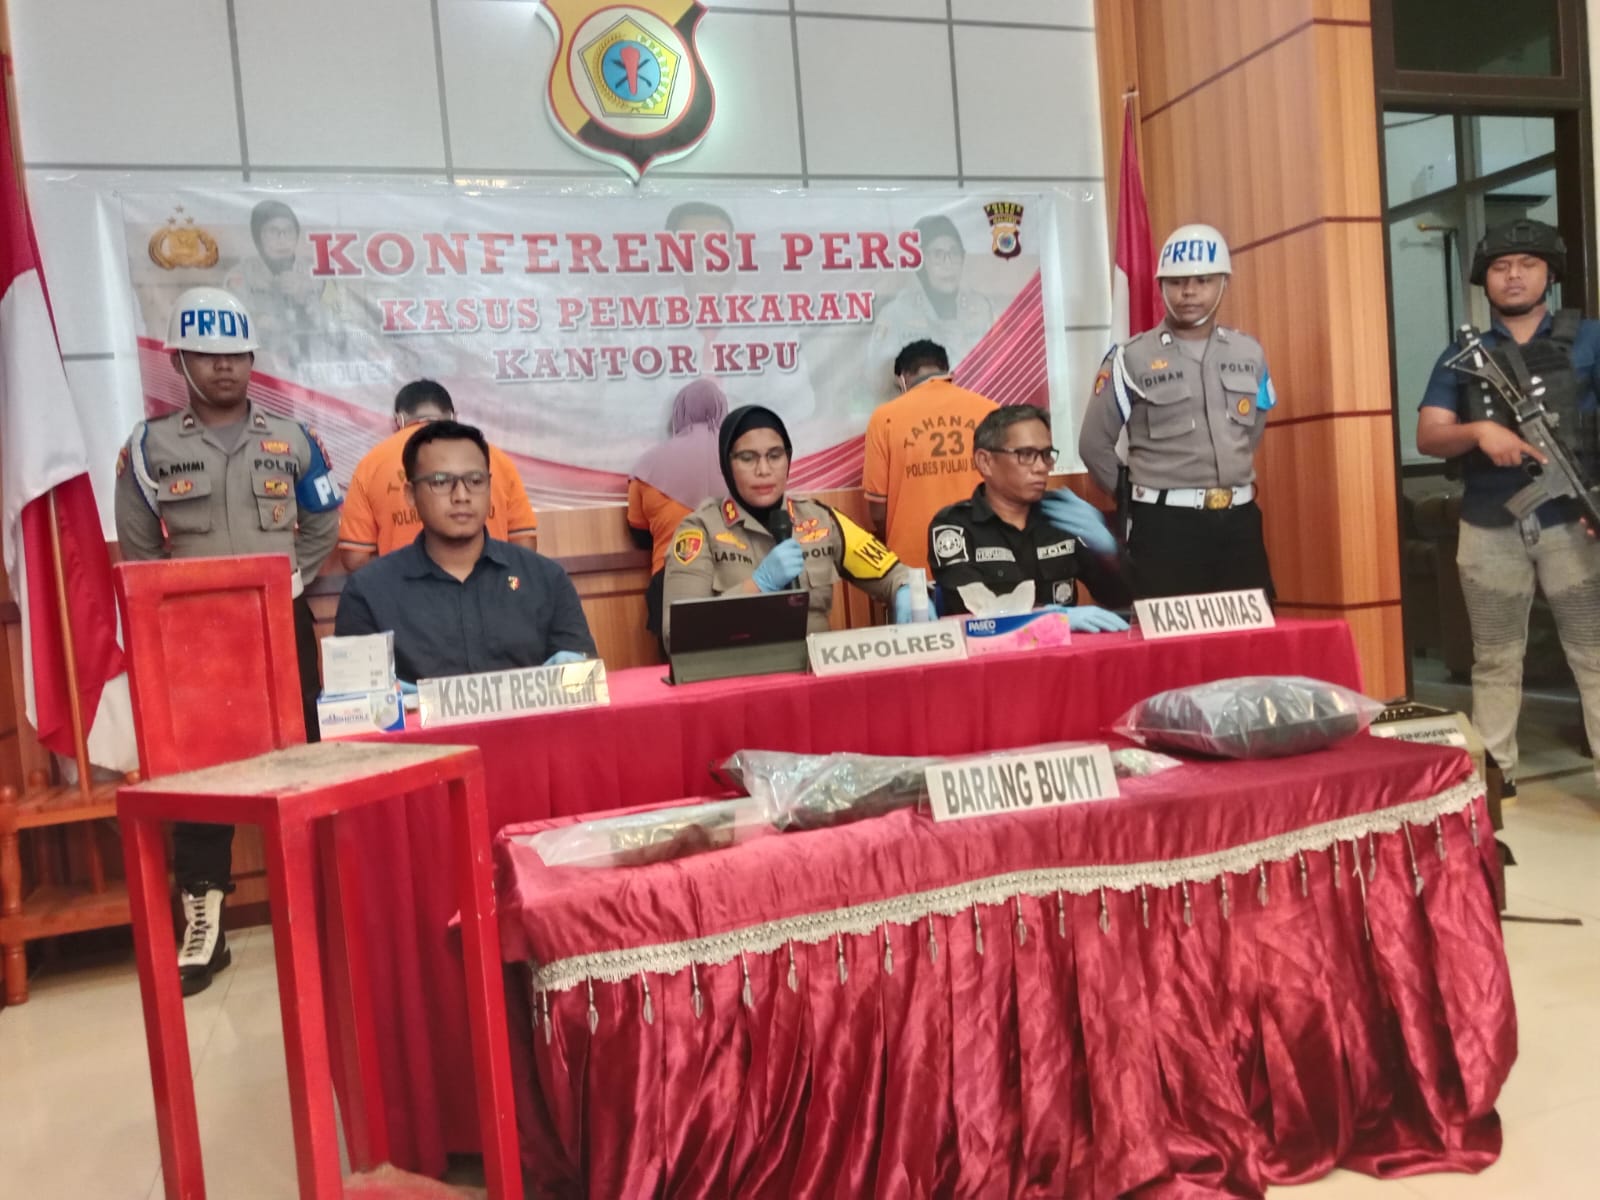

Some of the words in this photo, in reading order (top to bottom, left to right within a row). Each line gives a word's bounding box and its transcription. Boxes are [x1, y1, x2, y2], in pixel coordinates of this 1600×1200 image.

[309, 232, 759, 276] KONFERENSI
[782, 231, 923, 272] PERS
[1162, 240, 1217, 267] PROV
[181, 309, 249, 339] PROV
[381, 298, 540, 333] KASUS
[558, 292, 874, 329] PEMBAKARAN
[496, 343, 697, 380] KANTOR
[714, 342, 798, 372] KPU
[904, 416, 977, 449] TAHANA
[930, 431, 965, 458] 23
[254, 458, 299, 474] POLRI
[906, 460, 938, 478] POLRES
[941, 458, 968, 474] PULAU
[1149, 599, 1195, 633] KASI
[1199, 594, 1263, 628] HUMAS
[821, 631, 956, 665] KAPOLRES
[438, 676, 504, 717] KASAT
[942, 761, 1032, 815] BARANG
[1037, 754, 1102, 804] BUKTI
